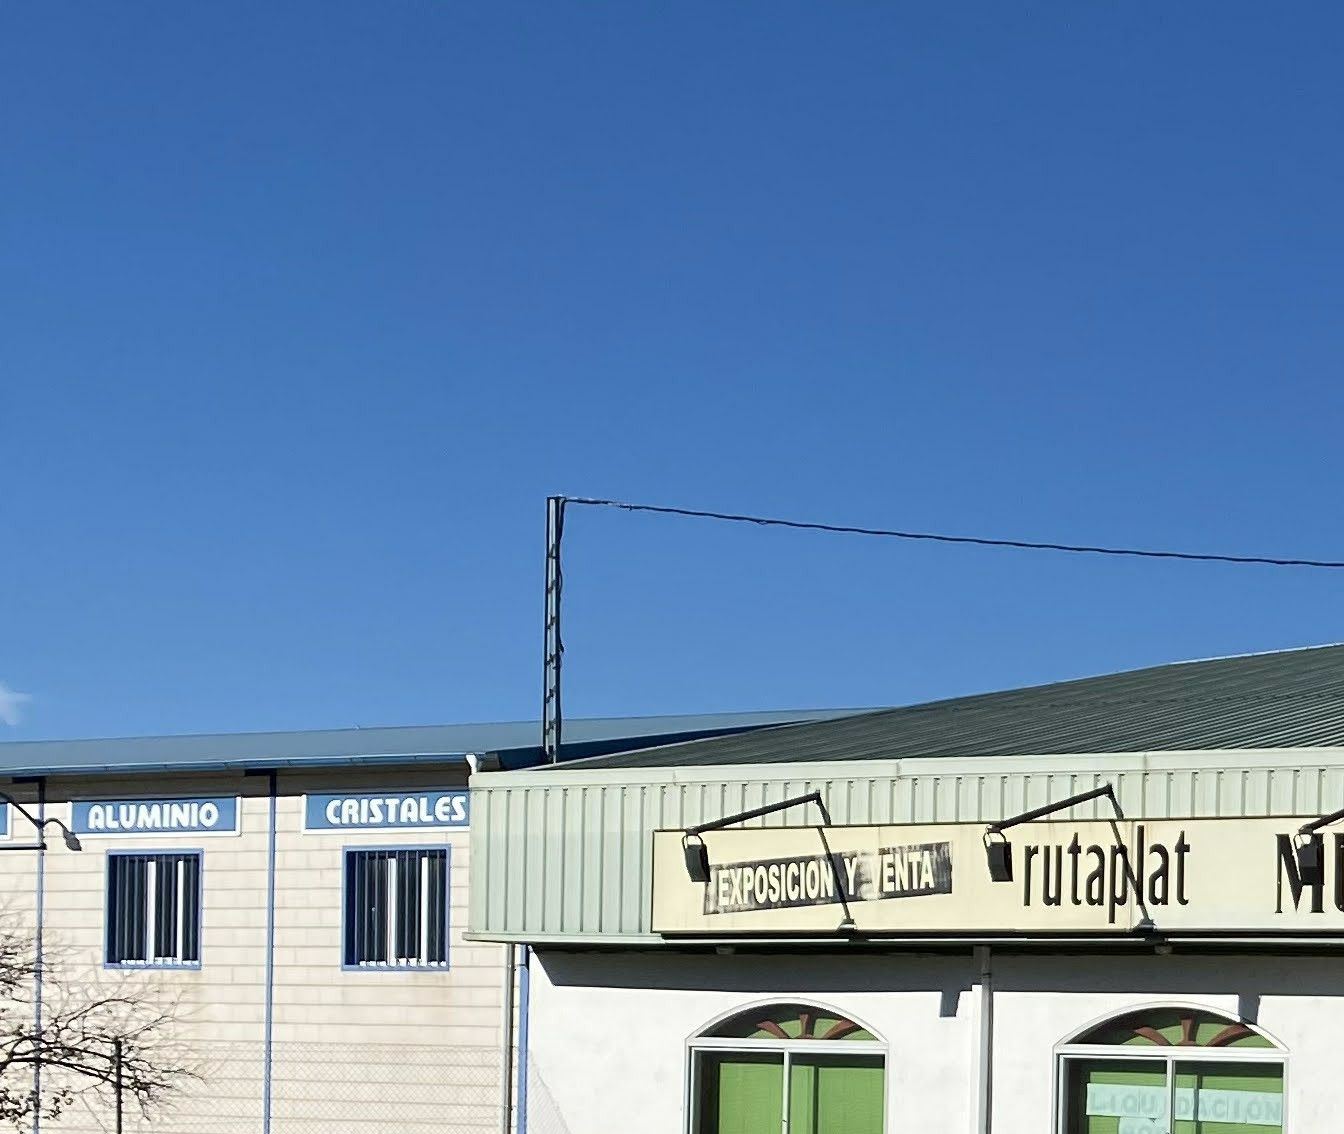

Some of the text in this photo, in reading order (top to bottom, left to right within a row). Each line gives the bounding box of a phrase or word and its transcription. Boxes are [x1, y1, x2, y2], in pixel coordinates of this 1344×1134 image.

[88, 802, 219, 829] ALUMINIO
[326, 796, 466, 825] CRISTALES
[716, 860, 834, 907] EXPOSICION
[842, 857, 858, 896] Y
[1023, 825, 1191, 923] rutaplat
